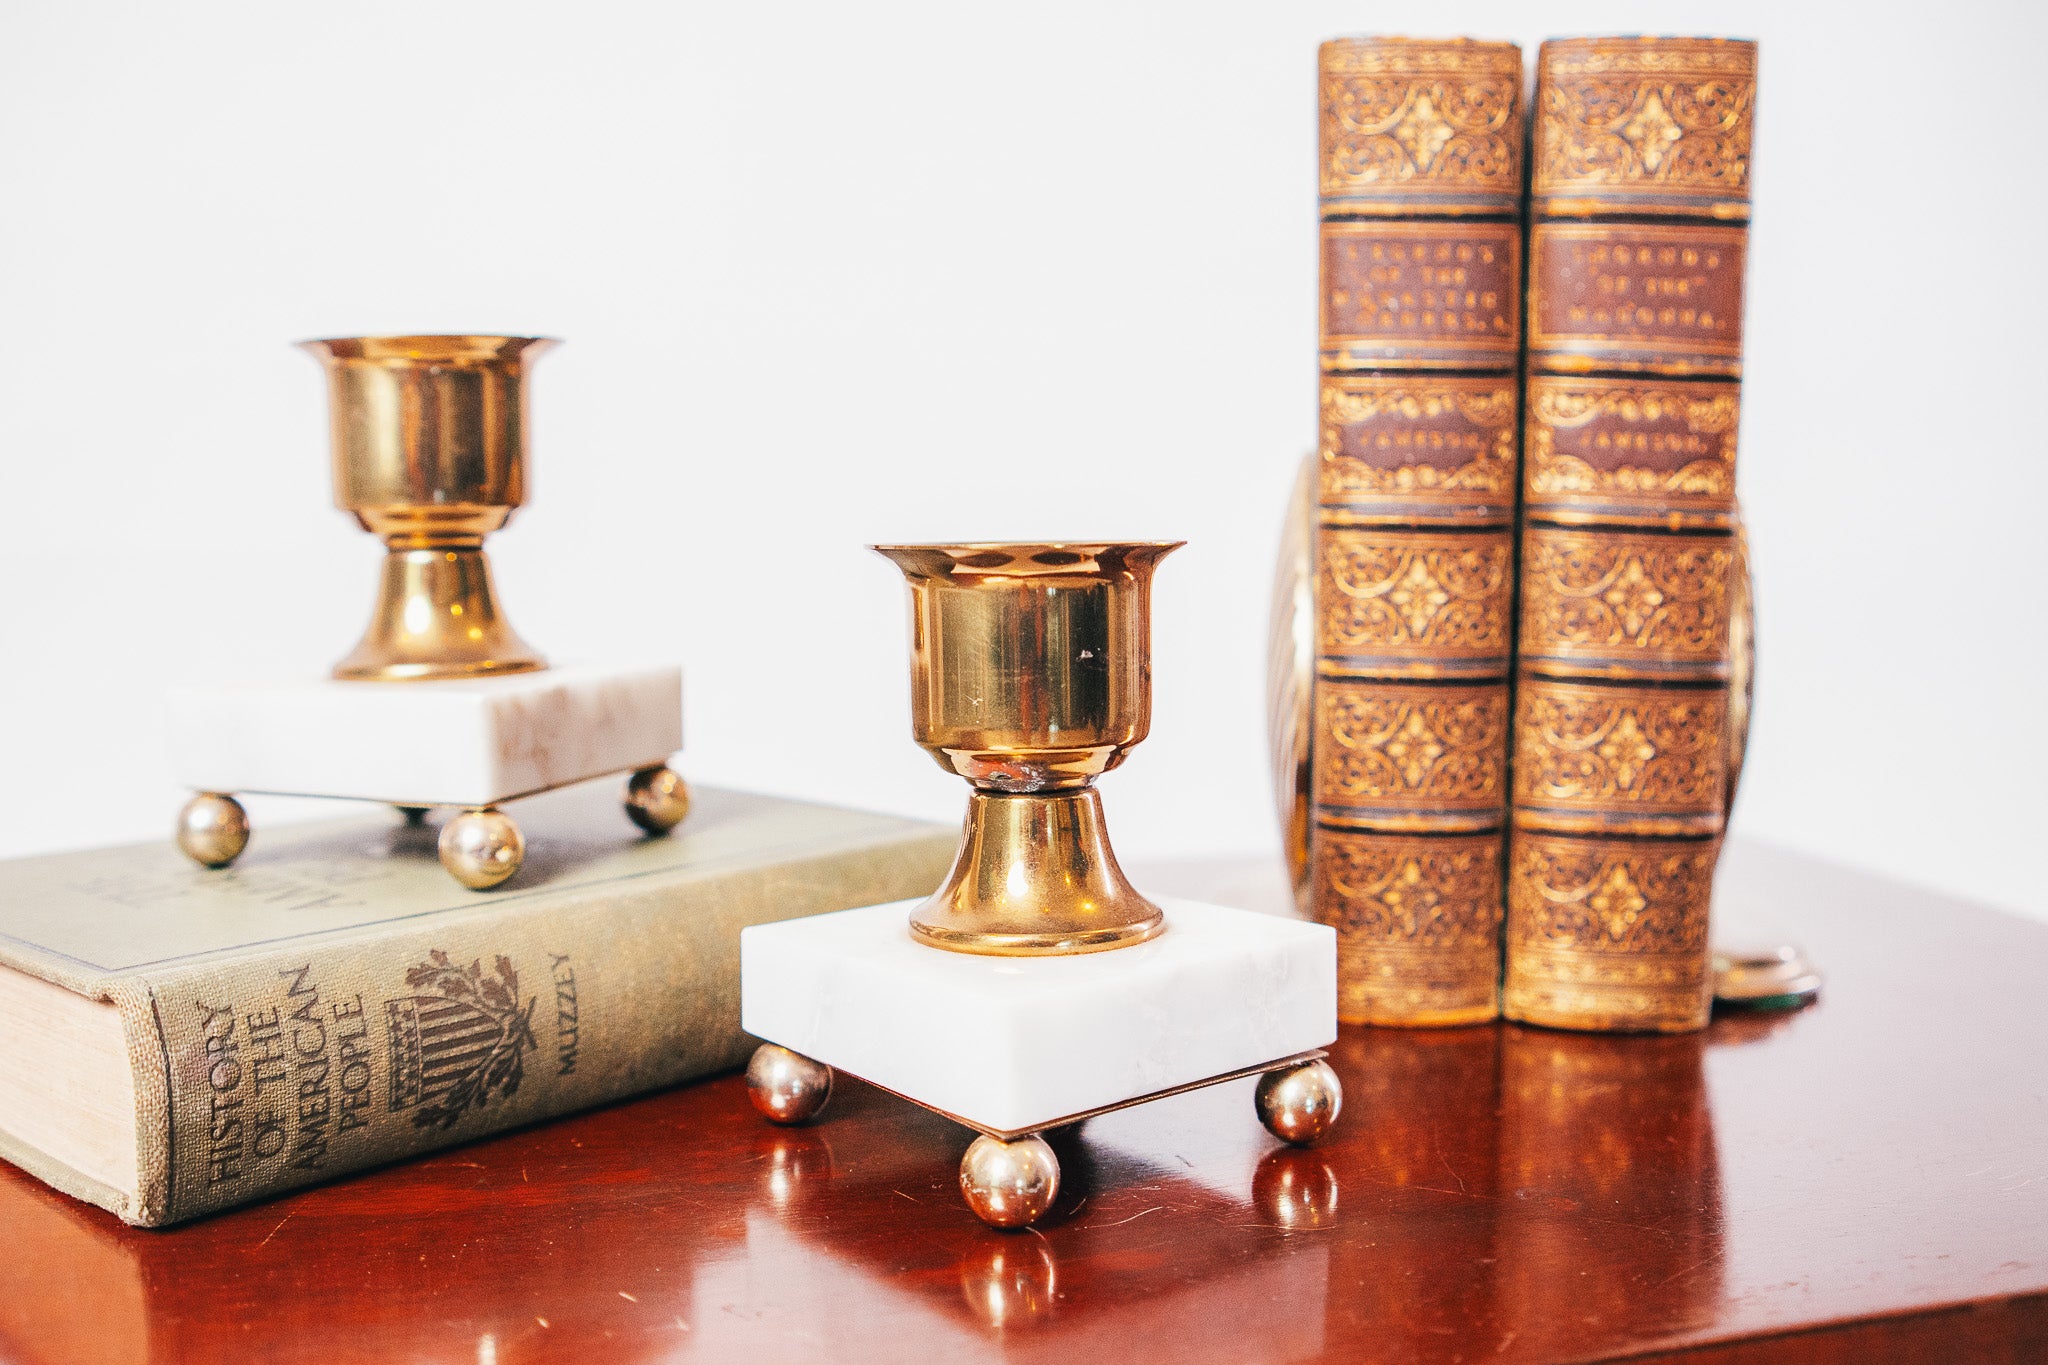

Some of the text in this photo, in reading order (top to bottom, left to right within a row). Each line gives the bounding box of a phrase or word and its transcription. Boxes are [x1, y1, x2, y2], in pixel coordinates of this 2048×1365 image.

[247, 1006, 287, 1158] OF THE
[279, 963, 330, 1169] AMERICAN
[332, 993, 371, 1133] PEOPLE
[547, 952, 579, 1076] MUZZEY
[196, 1000, 243, 1187] HISTORY
